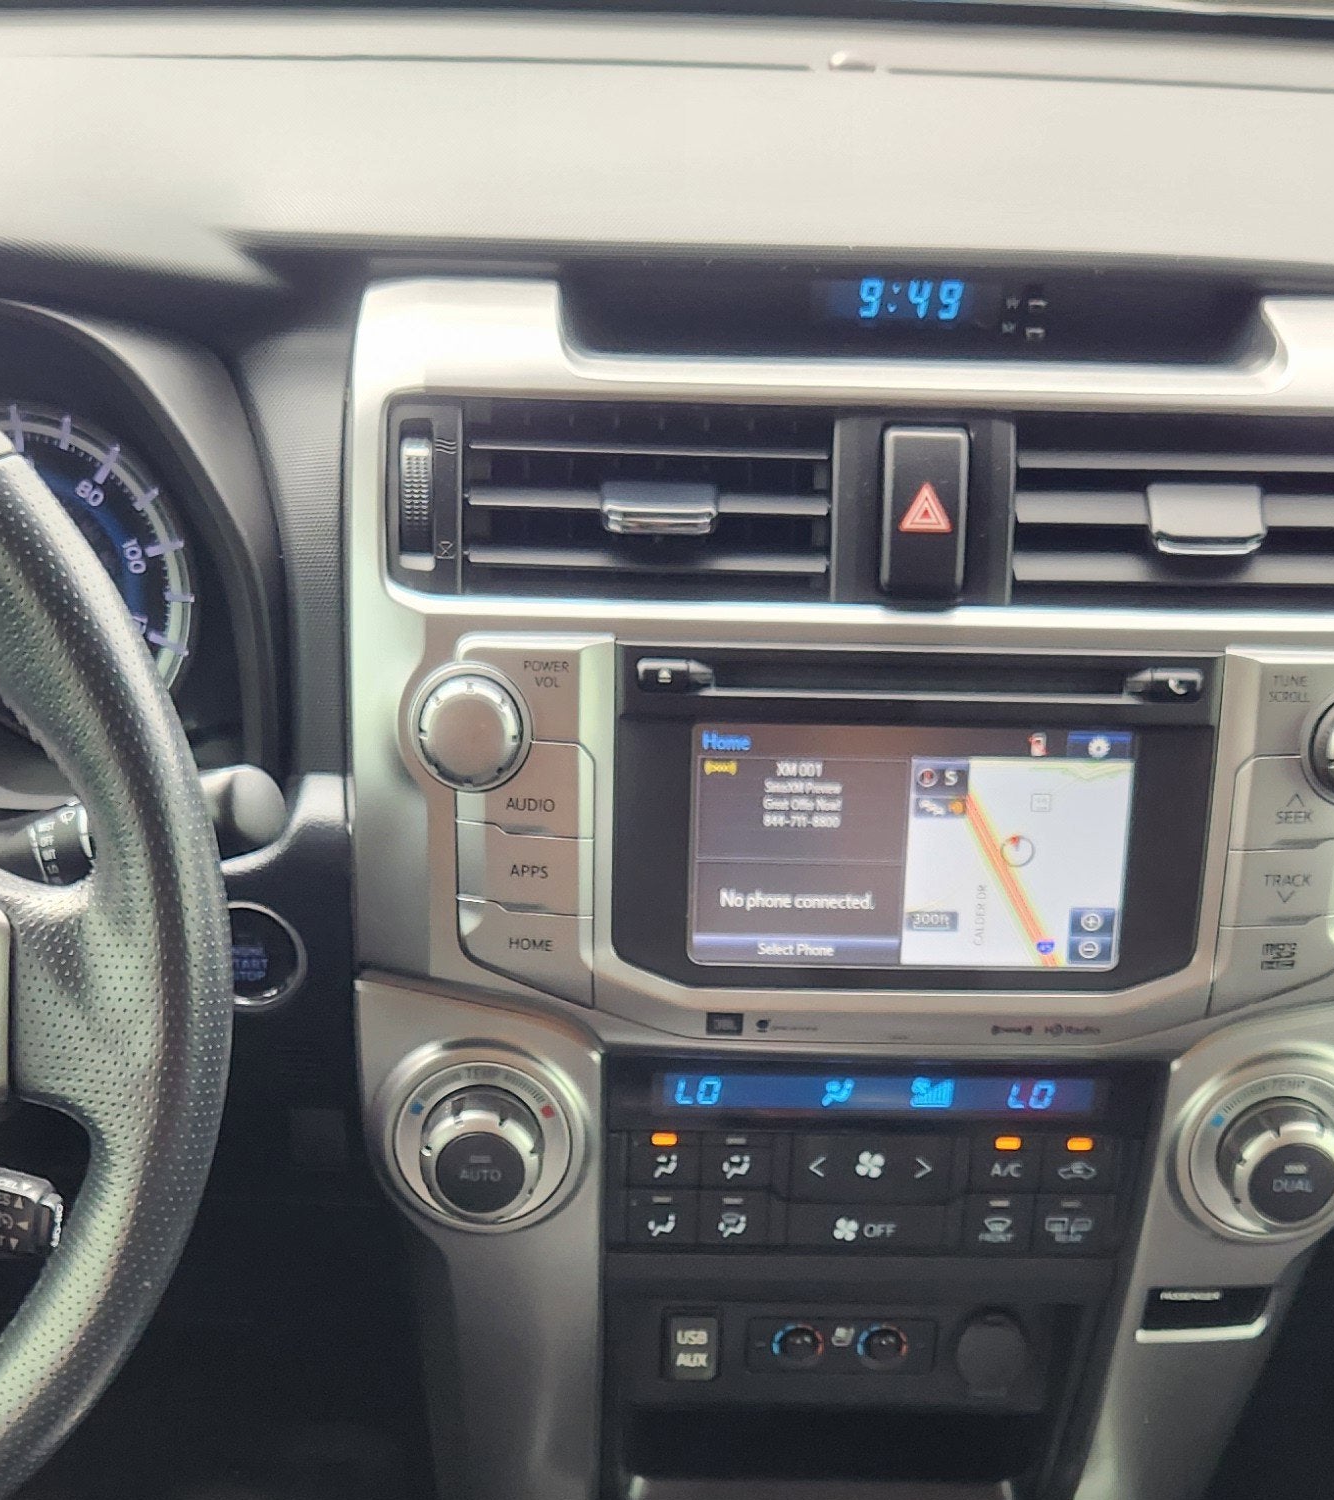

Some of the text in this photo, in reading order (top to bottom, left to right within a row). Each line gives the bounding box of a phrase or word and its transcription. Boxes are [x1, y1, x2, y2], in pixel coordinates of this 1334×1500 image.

[859, 277, 965, 321] 9:49
[75, 479, 106, 507] 80
[122, 538, 147, 575] 100
[523, 660, 569, 674] POWER
[534, 676, 560, 689] VOL
[702, 731, 752, 751] Home
[776, 761, 797, 777] XM
[944, 769, 959, 787] S
[506, 798, 555, 813] AUDIO
[1275, 811, 1312, 825] SEEK
[510, 864, 549, 880] APPS
[1264, 874, 1312, 888] TRACK
[720, 889, 875, 911] No phone connected.
[508, 937, 553, 952] HOME
[757, 942, 835, 957] Select Phone
[674, 1077, 722, 1106] LO
[1007, 1080, 1056, 1109] LO
[459, 1168, 502, 1182] AUTO
[990, 1162, 1023, 1178] A/C
[863, 1222, 897, 1239] OFF
[676, 1329, 709, 1346] USB
[676, 1351, 709, 1368] AUX
